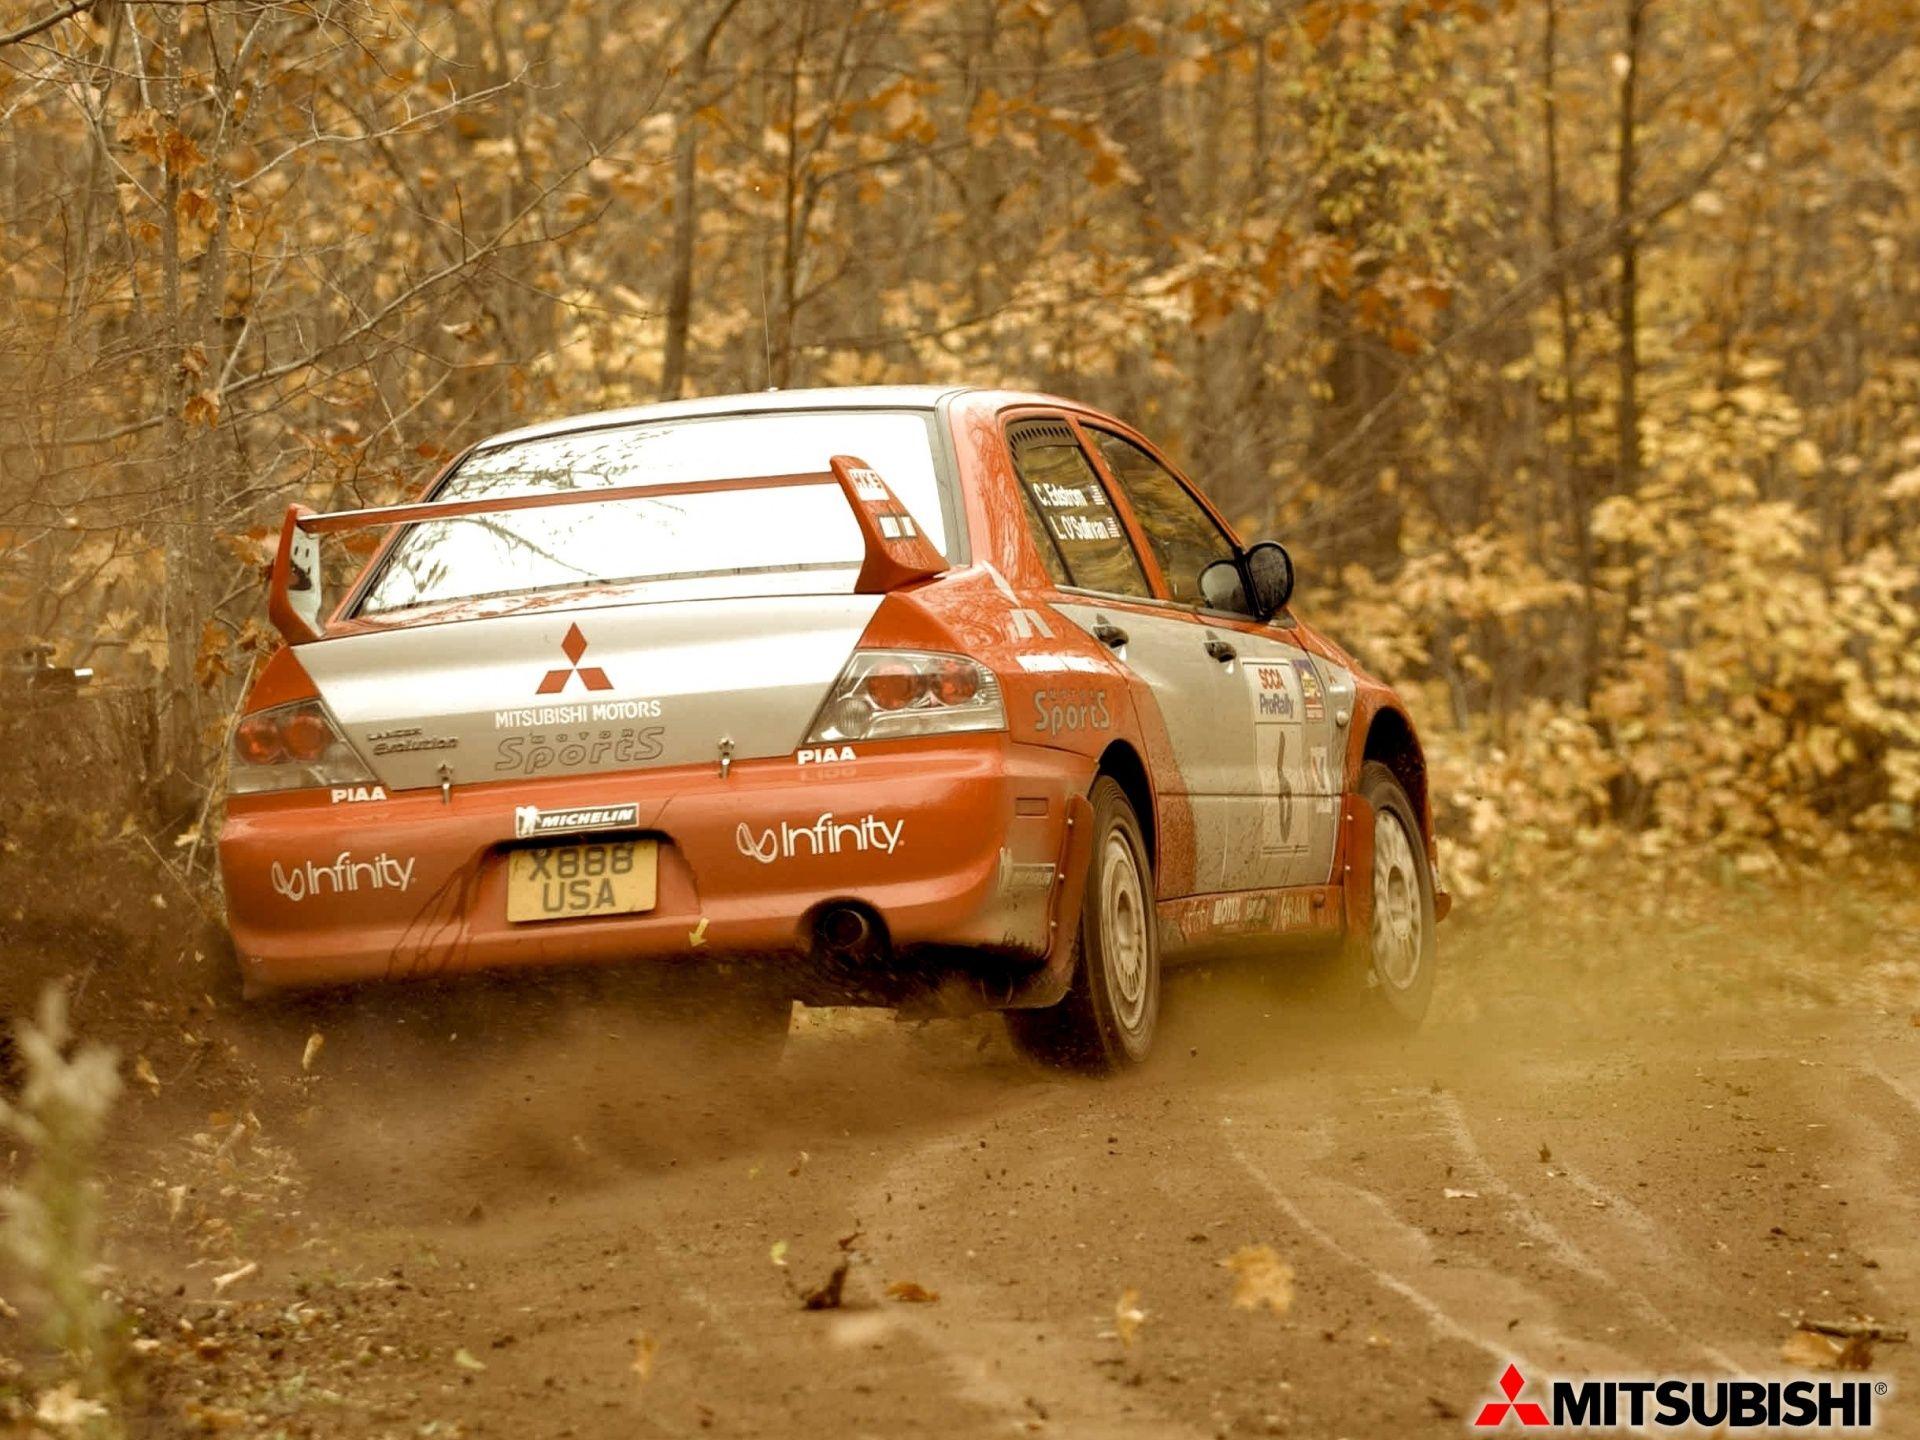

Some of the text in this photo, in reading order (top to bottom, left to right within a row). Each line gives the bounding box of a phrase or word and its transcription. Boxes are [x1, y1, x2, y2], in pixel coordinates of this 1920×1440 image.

[1258, 667, 1286, 690] SCCA
[495, 700, 662, 729] MITSUBISHI MOTORS
[1259, 693, 1295, 719] ProRally
[797, 746, 857, 765] PIAA
[331, 786, 387, 803] PIAA
[541, 809, 634, 827] MICHELIN
[781, 812, 904, 857] Infinity
[307, 852, 416, 895] Infinity
[529, 843, 634, 881] X888
[542, 877, 616, 912] USA
